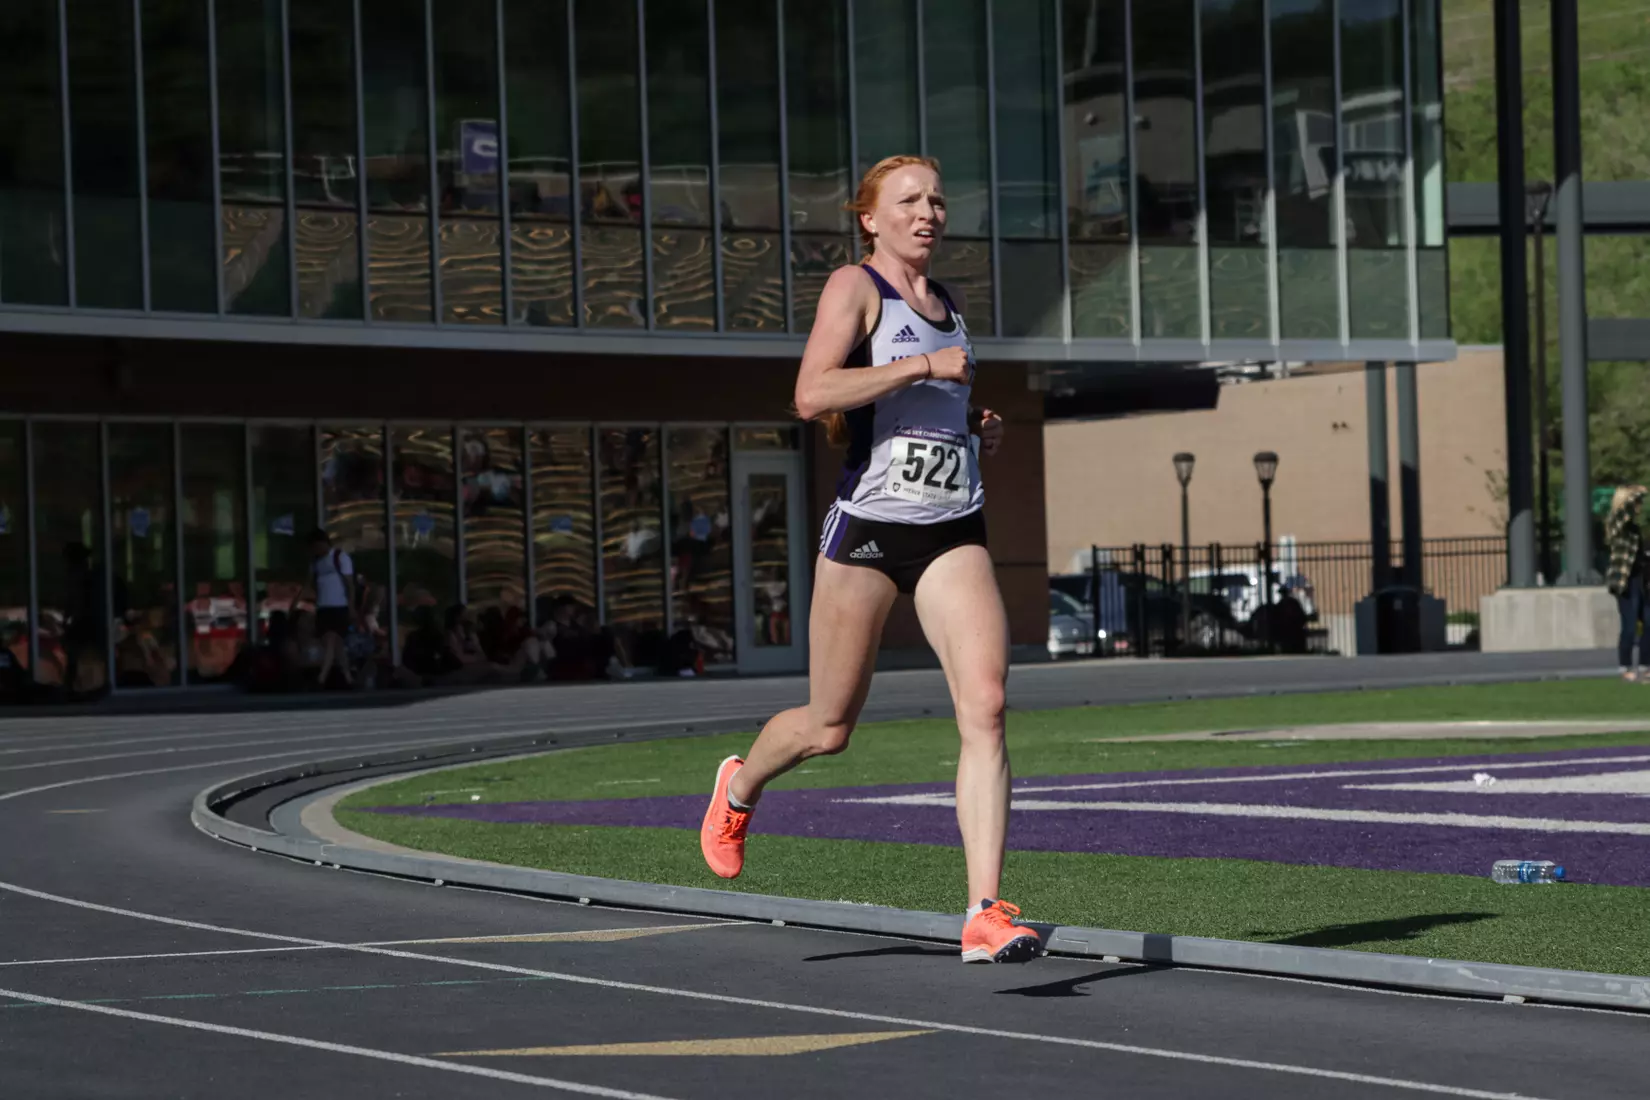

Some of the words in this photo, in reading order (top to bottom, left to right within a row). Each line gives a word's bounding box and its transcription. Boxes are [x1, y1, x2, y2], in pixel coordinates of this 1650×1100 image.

[892, 335, 920, 343] adidas
[902, 442, 960, 491] 522
[849, 551, 884, 559] adidas
